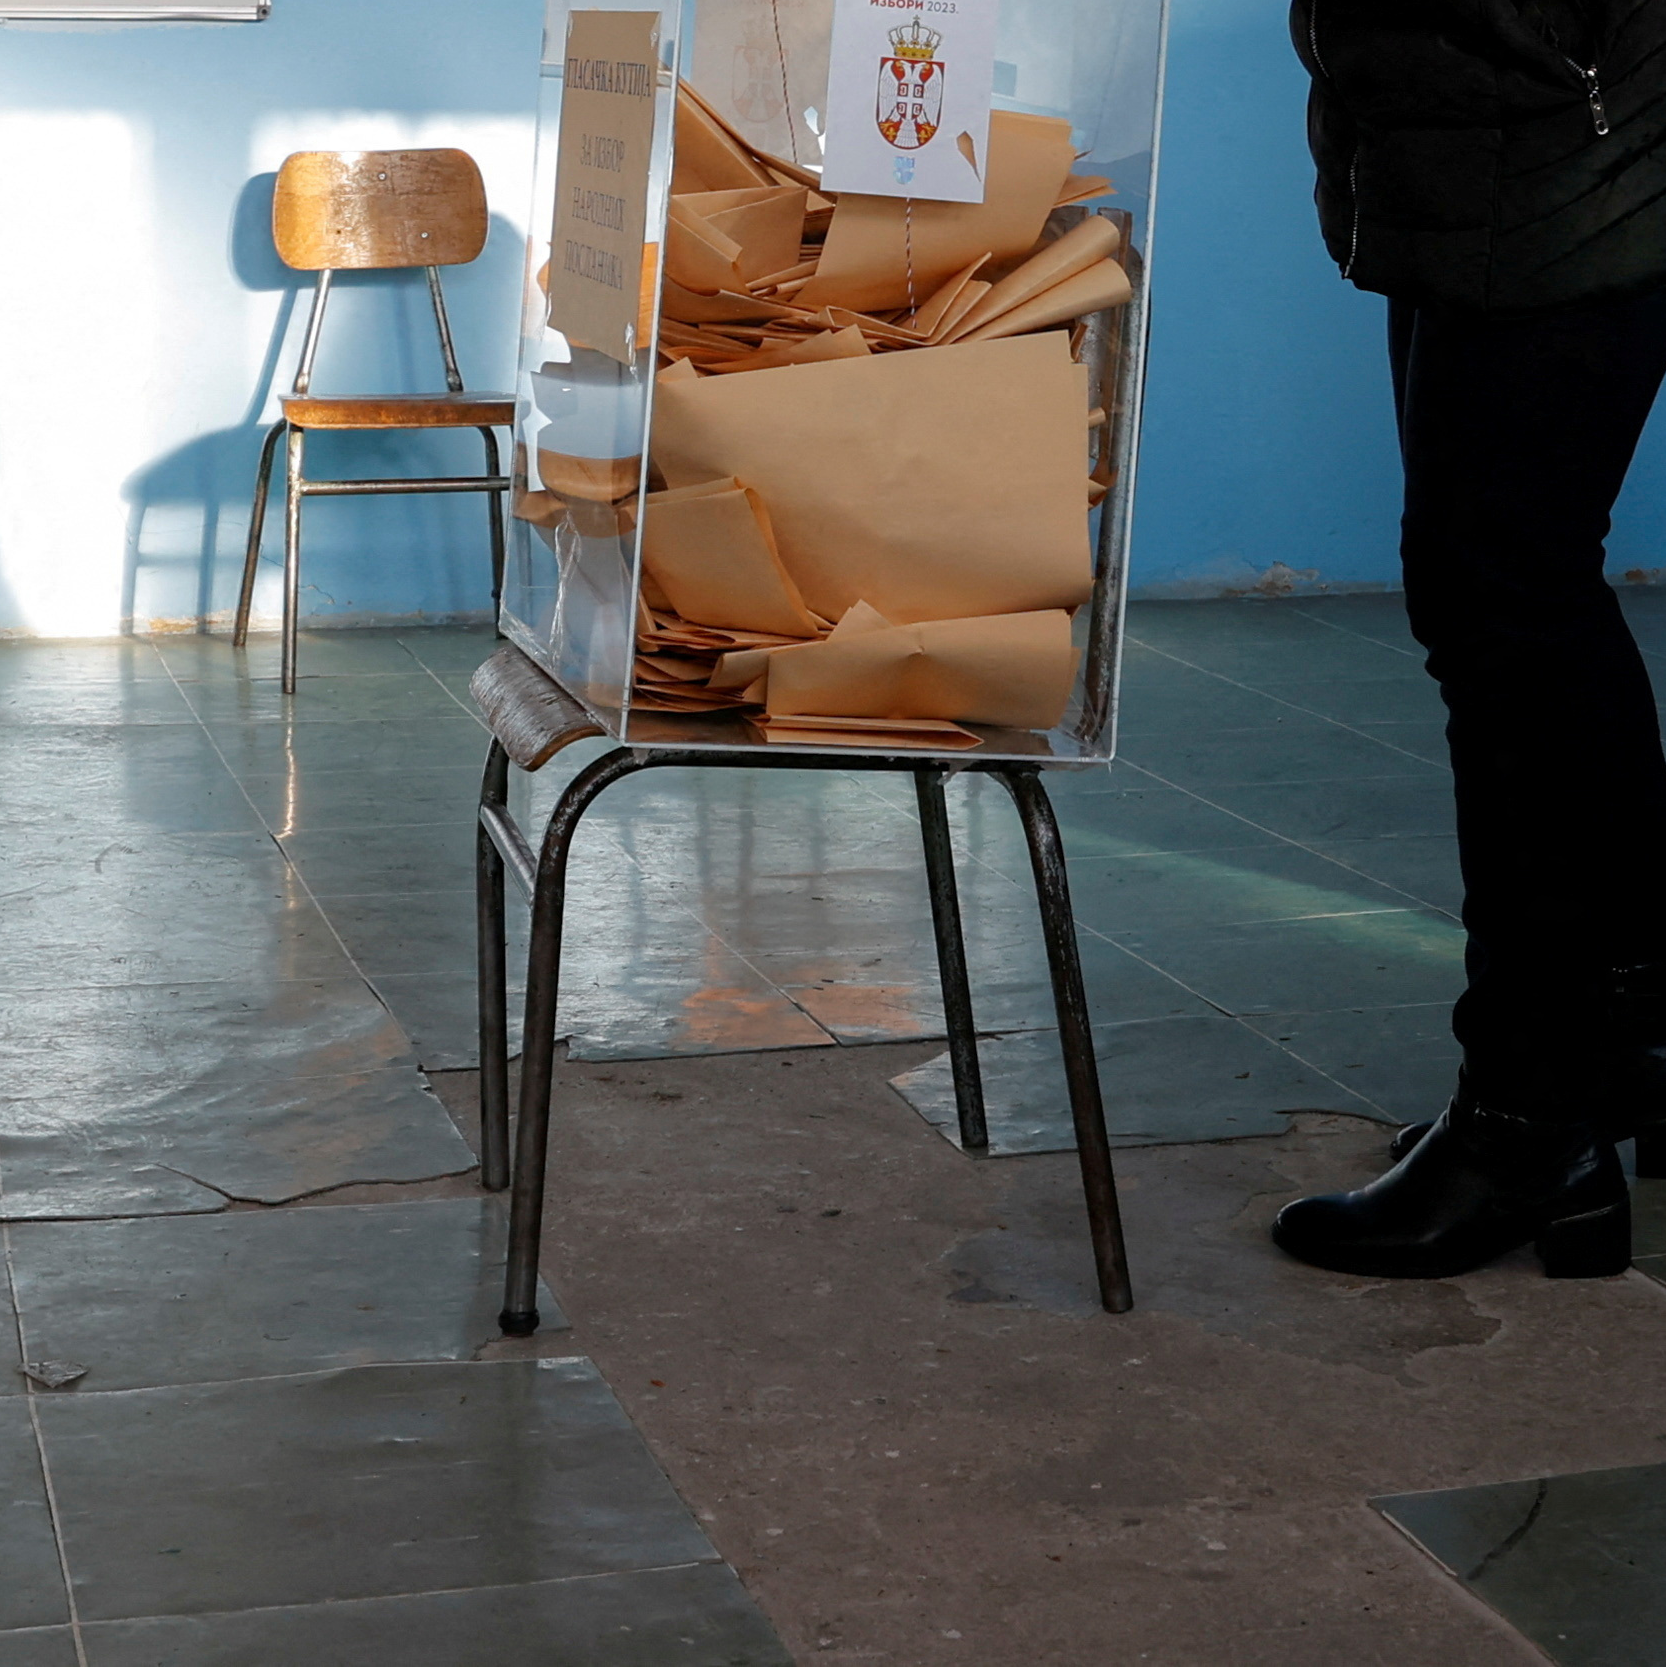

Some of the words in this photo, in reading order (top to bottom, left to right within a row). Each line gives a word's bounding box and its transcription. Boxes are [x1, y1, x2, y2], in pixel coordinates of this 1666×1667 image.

[926, 0, 960, 15] 2023.
[566, 58, 613, 93] ГЛАСАЧКА
[613, 62, 652, 102] КУТИЈА
[580, 133, 592, 167] ЗА
[593, 136, 625, 173] ИЗБОР
[571, 186, 626, 232] НАРОДНИХ
[564, 239, 624, 291] ПОСЛАНИКА
